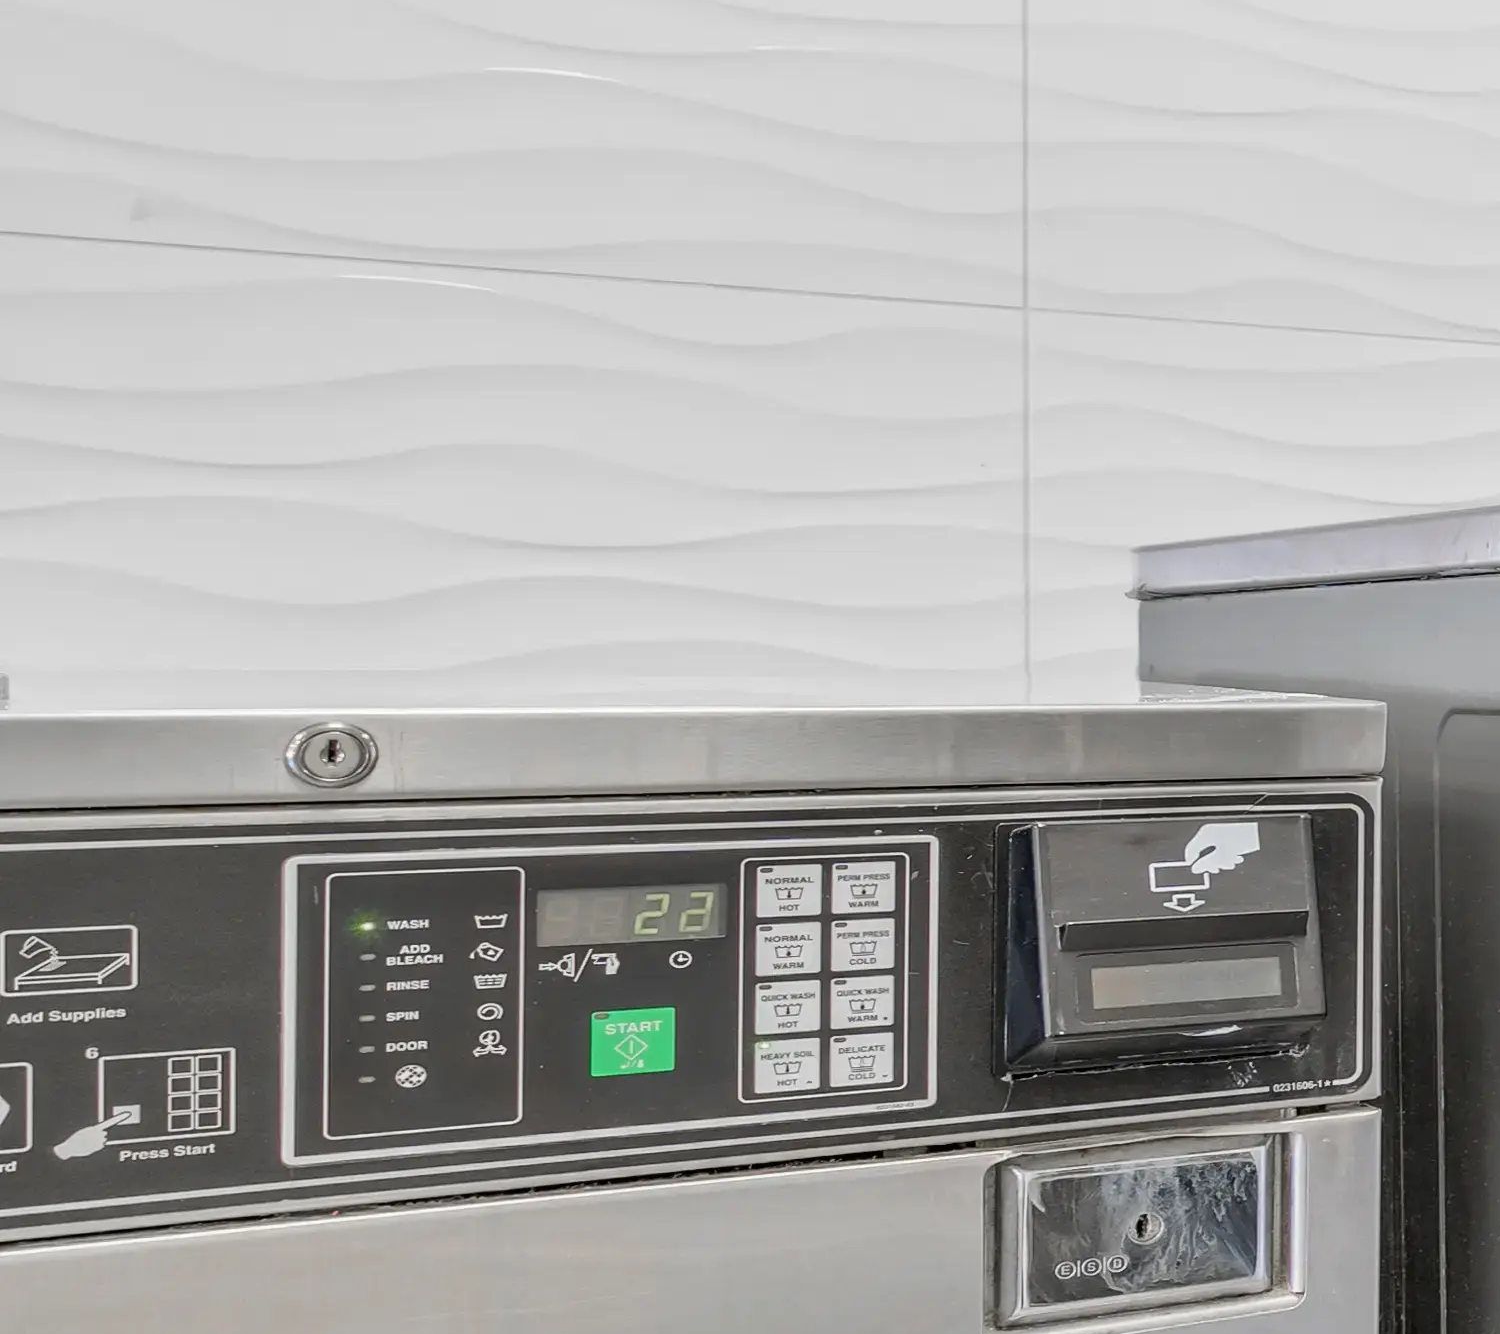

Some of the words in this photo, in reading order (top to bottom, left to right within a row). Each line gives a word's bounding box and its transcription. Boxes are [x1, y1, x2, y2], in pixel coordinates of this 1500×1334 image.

[765, 876, 814, 885] NORMAL
[863, 873, 890, 881] PRESS
[778, 904, 800, 912] HOT
[848, 900, 879, 908] WARM
[387, 919, 430, 930] WASH
[764, 934, 813, 943] NORMAL
[836, 931, 860, 939] PERM
[862, 930, 890, 938] PRESS
[400, 944, 430, 954] ADD
[386, 954, 444, 966] BLEACH
[849, 957, 877, 965] COLD
[773, 961, 804, 970] WARM
[386, 980, 430, 991] RINSE
[761, 994, 788, 1002] QUICK
[790, 992, 816, 1000] WASH
[836, 989, 863, 998] QUICK
[864, 987, 890, 995] WASH
[6, 1011, 44, 1025] Add
[48, 1007, 126, 1023] Supplies
[386, 1011, 419, 1022] SPIN
[847, 1015, 878, 1023] WARM
[604, 1020, 663, 1035] START
[777, 1021, 799, 1029] HOT
[385, 1040, 428, 1052] DOOR
[838, 1045, 886, 1054] DELICATE
[84, 1047, 99, 1059] 6
[760, 1052, 791, 1060] HEAVY
[793, 1050, 815, 1058] SOIL
[848, 1072, 876, 1080] COLD
[777, 1079, 798, 1087] HOT
[119, 1149, 169, 1162] Press
[173, 1143, 216, 1157] Start
